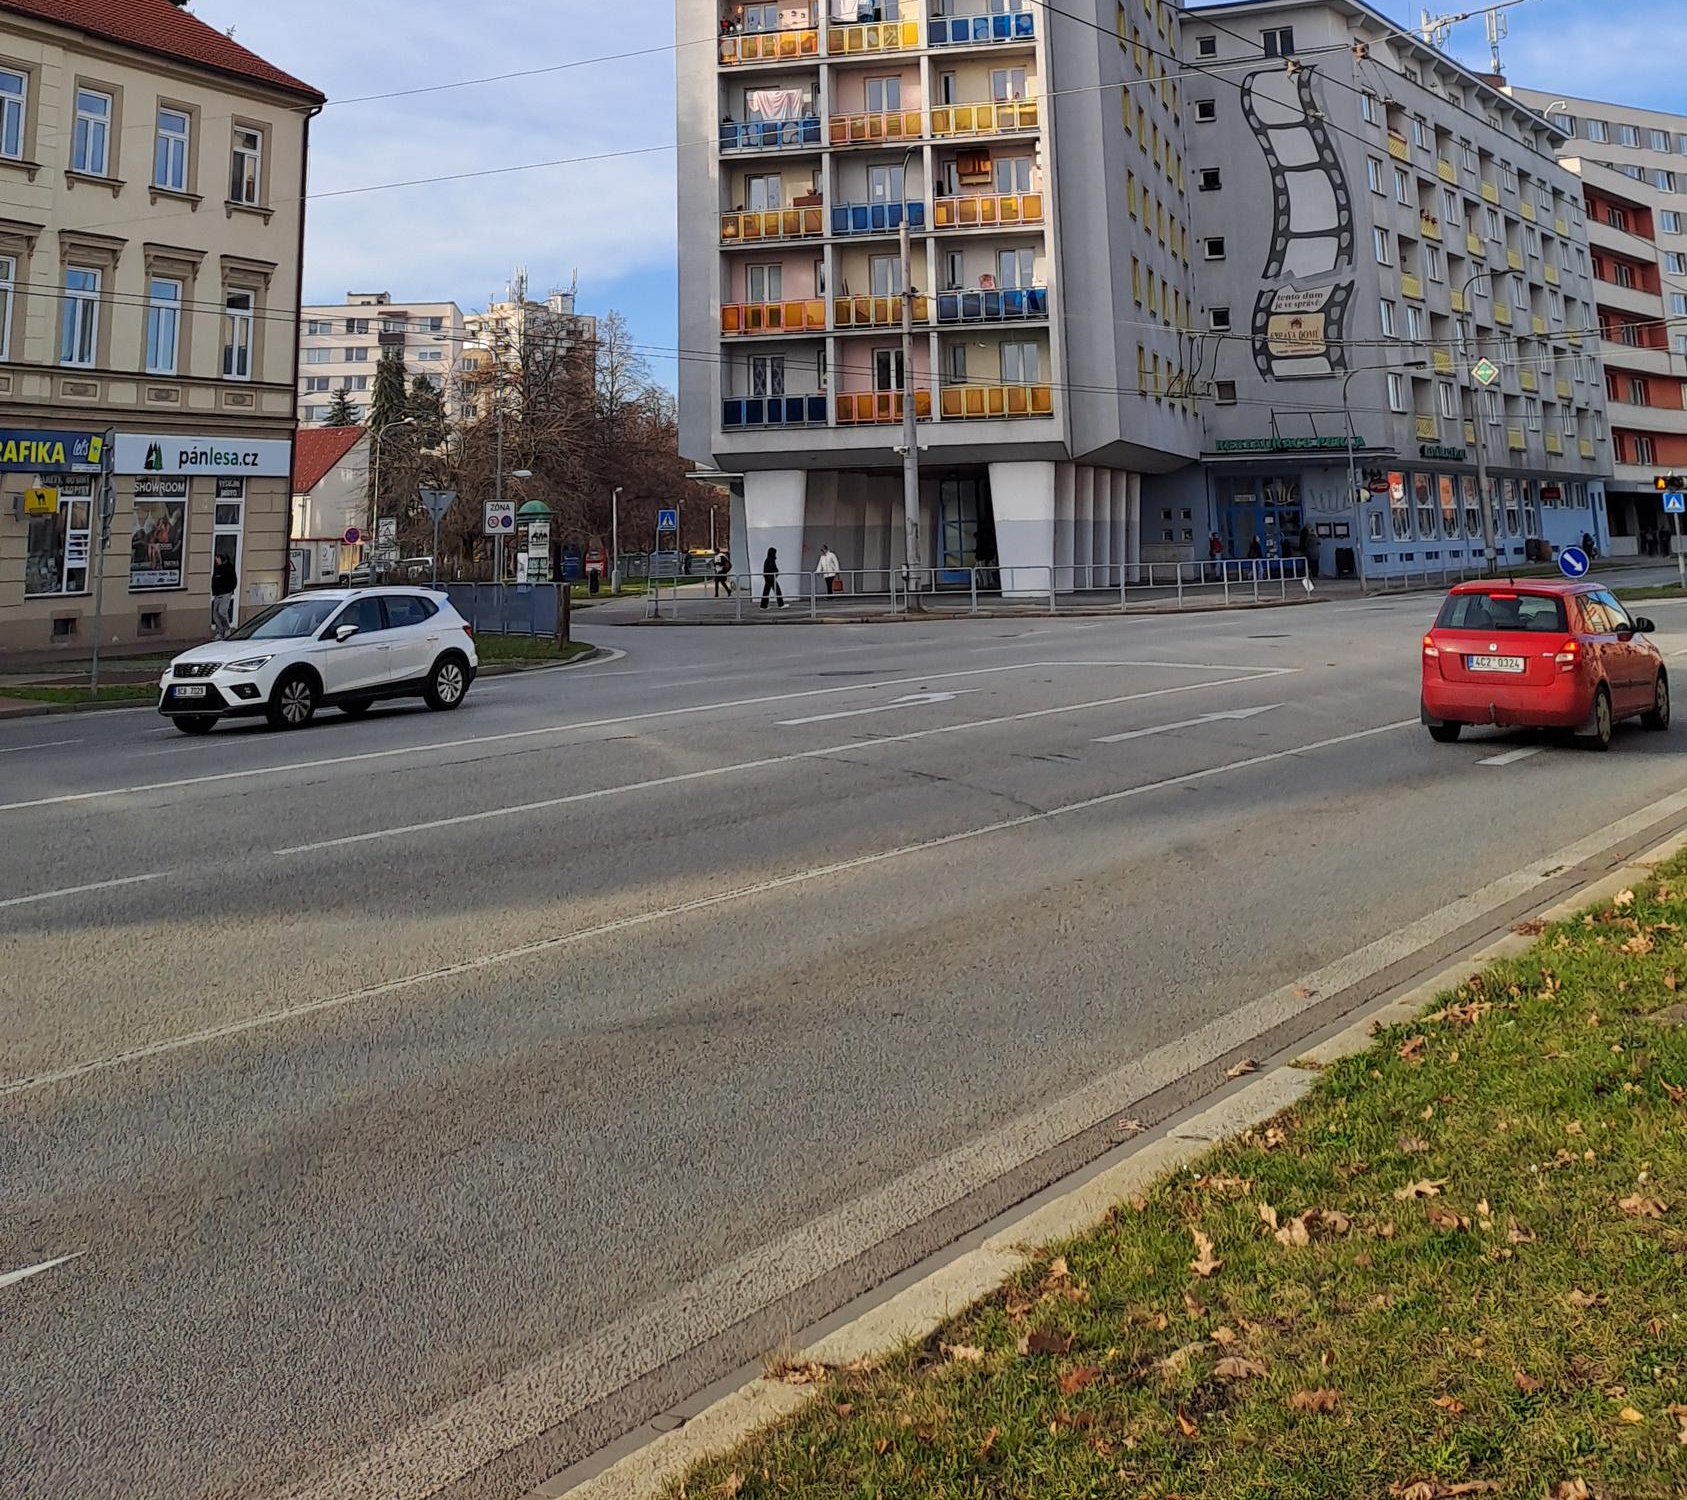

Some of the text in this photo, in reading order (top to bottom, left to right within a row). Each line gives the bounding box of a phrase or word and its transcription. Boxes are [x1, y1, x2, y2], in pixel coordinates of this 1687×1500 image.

[1277, 293, 1300, 301] tento
[0, 439, 65, 464] AFIKA
[179, 446, 259, 469] pánlesa.cz
[134, 481, 185, 493] SHOWROOM
[1475, 657, 1520, 669] 4C2 0324
